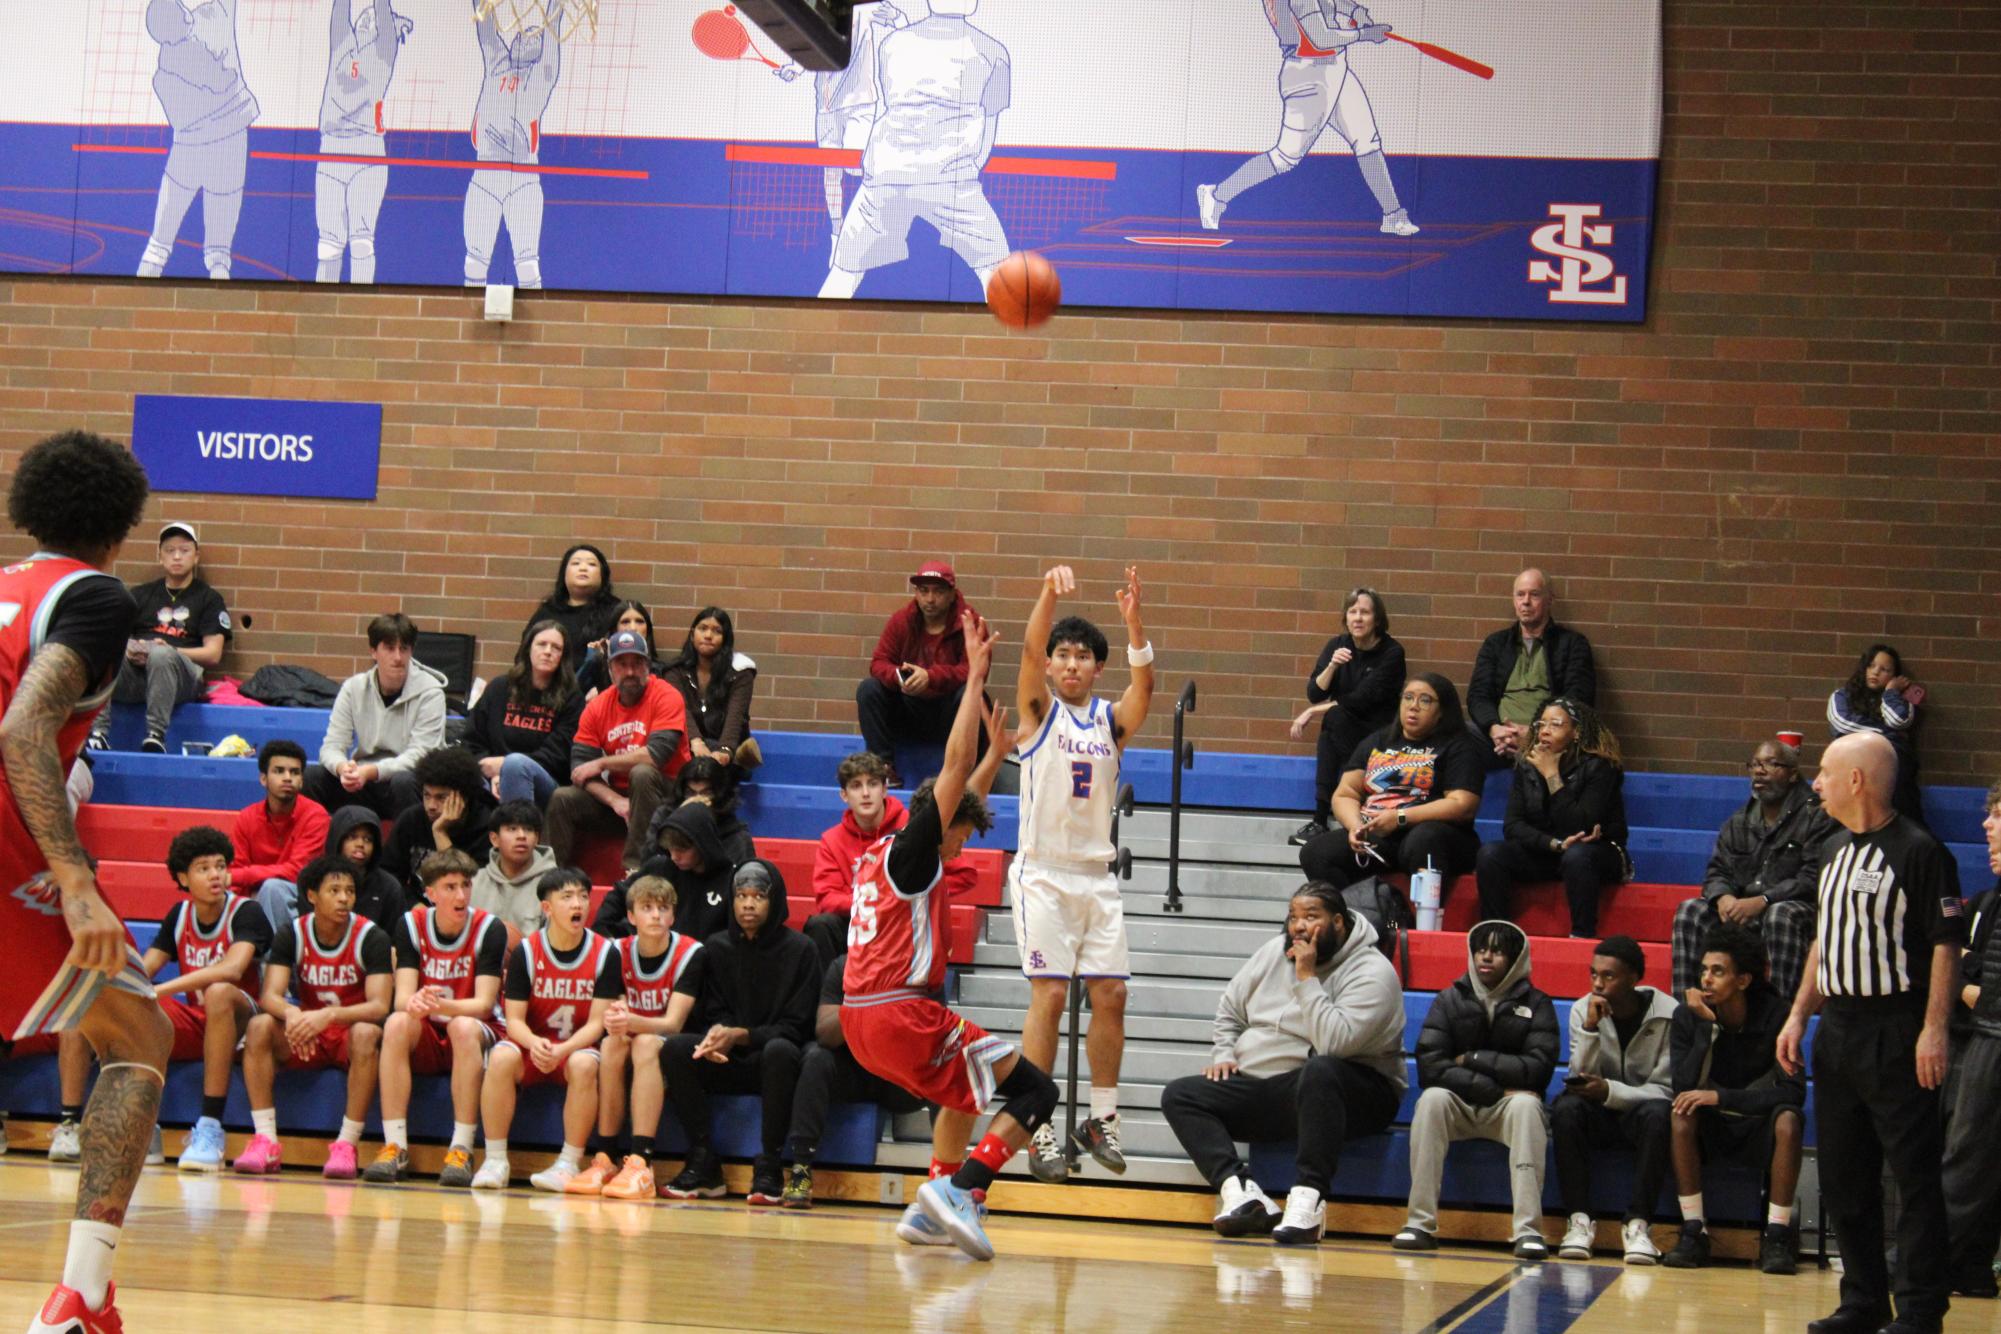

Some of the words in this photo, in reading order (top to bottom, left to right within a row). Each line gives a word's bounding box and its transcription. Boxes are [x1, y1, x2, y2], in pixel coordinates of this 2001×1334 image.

[197, 431, 313, 462] VISITORS
[503, 711, 553, 733] EAGLES
[1071, 761, 1093, 799] 2
[185, 943, 225, 967] EGL
[422, 954, 472, 980] AGLES
[533, 976, 595, 1001] EAGLES
[626, 985, 671, 1011] EGLE
[546, 1004, 577, 1040] 4
